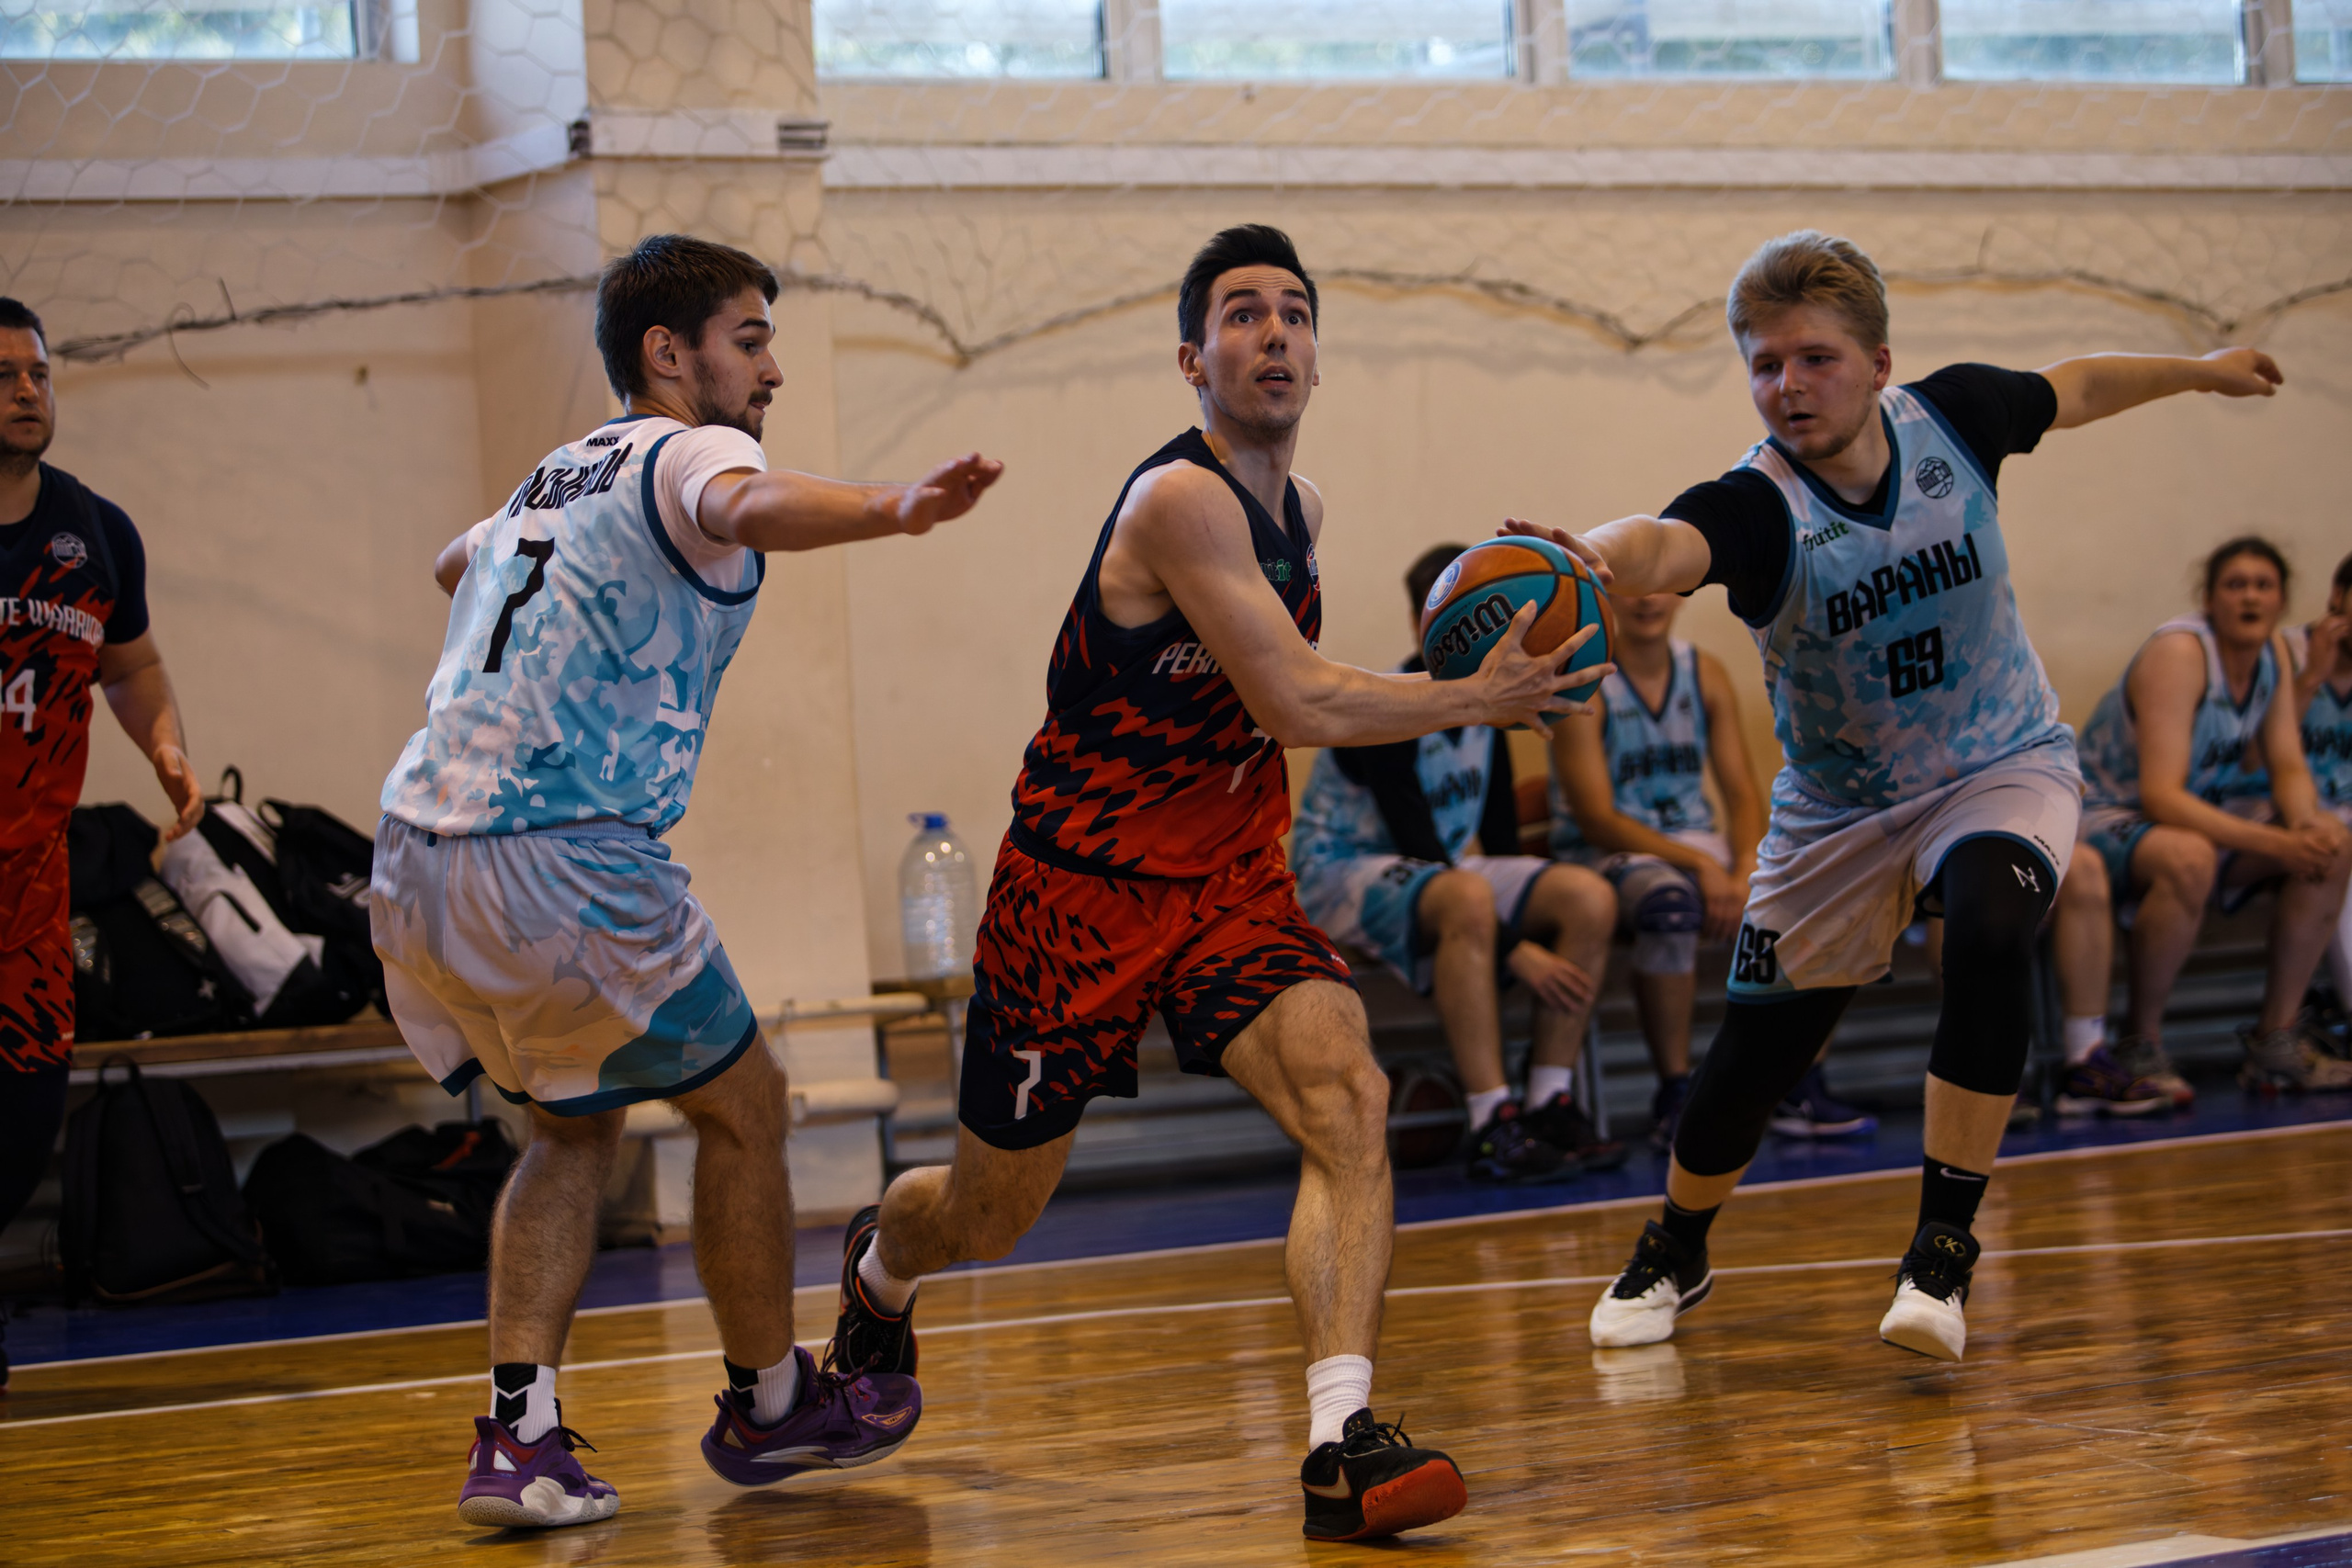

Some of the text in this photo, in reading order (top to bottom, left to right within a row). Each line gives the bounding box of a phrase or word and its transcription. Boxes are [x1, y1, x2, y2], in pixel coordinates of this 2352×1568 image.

[586, 436, 619, 446] MAXX
[482, 536, 555, 672] 7
[1826, 533, 1982, 637] ВАРАНЫ
[1886, 626, 1943, 698] 69
[1012, 1050, 1041, 1120] 7
